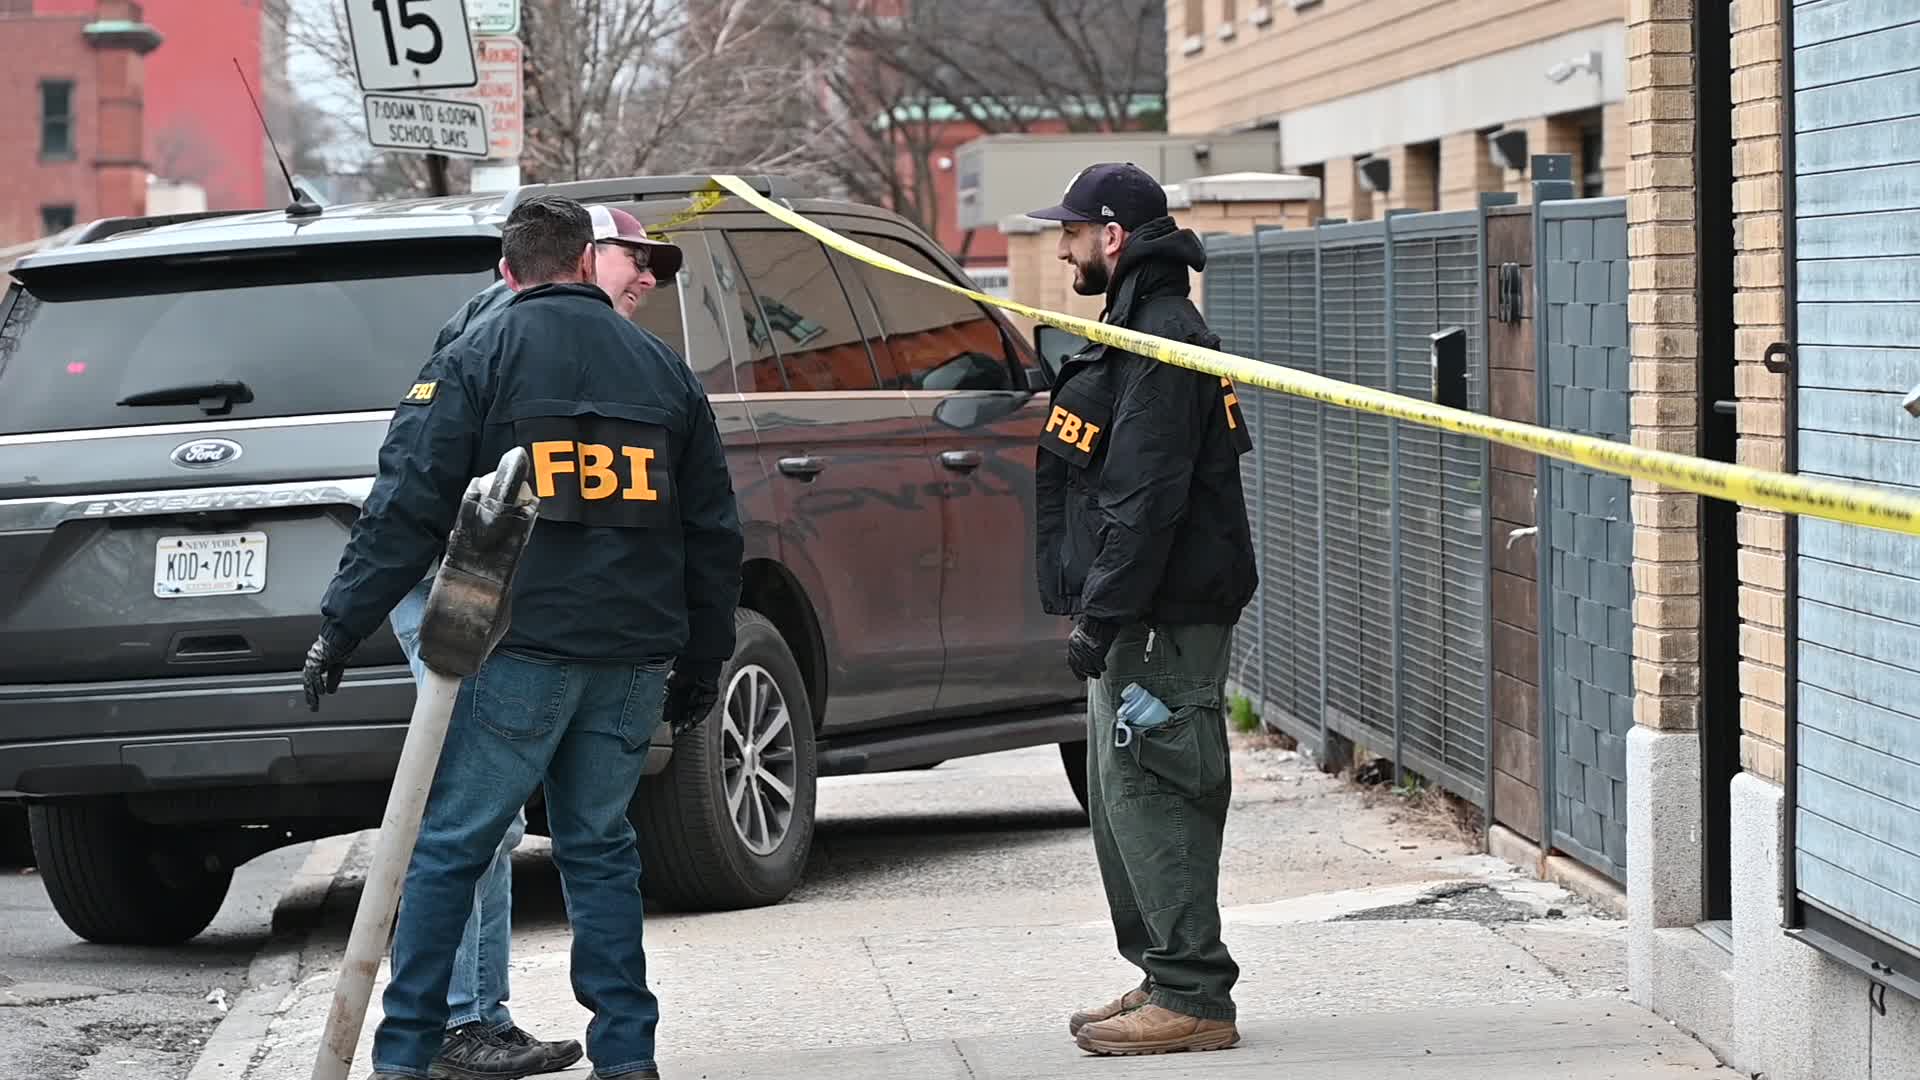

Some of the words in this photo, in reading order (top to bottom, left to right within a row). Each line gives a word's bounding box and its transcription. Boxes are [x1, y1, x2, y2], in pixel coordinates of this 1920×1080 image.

[372, 0, 443, 66] 15
[372, 101, 417, 120] 7:00AM
[419, 103, 433, 122] TO
[437, 106, 478, 127] 6:00PM
[389, 123, 437, 145] SCHOOL
[441, 127, 469, 149] DAYS
[406, 381, 438, 400] FBI
[1045, 404, 1100, 454] FBI
[185, 444, 225, 462] Ford
[531, 440, 658, 501] FBI
[83, 487, 328, 516] EXPEDITION
[185, 541, 209, 550] NEW
[212, 539, 238, 549] YORK
[167, 552, 199, 581] KDD
[213, 549, 255, 579] 7012
